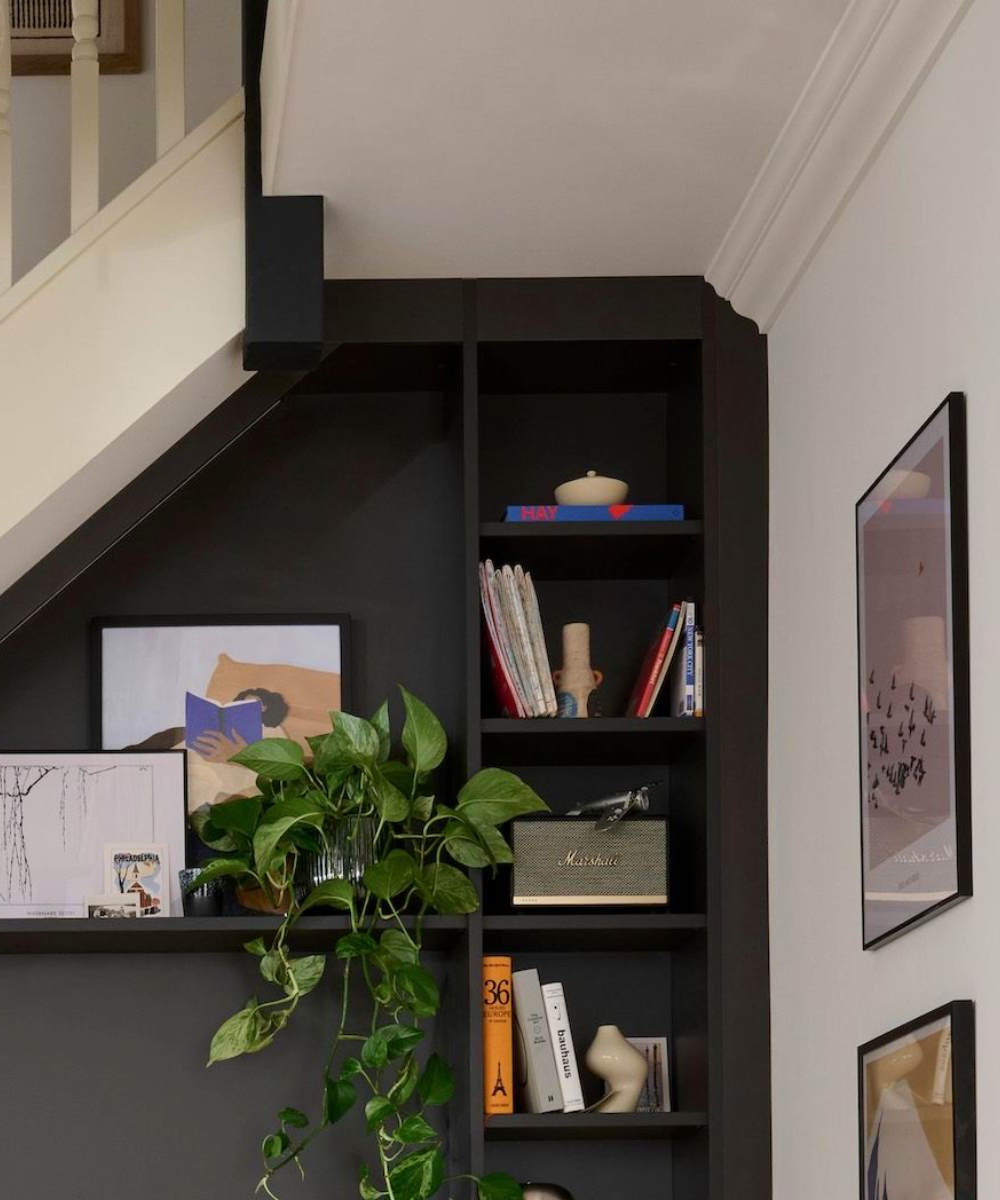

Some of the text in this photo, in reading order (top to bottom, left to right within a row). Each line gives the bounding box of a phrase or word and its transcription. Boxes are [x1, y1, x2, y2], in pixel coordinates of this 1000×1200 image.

[521, 505, 557, 520] HAY
[686, 642, 694, 660] YORK
[686, 660, 694, 675] CITY
[114, 853, 160, 863] PHILADELPHIA
[558, 850, 619, 866] Marshall
[484, 979, 510, 1005] 36
[483, 1010, 512, 1018] EUROPE
[557, 1029, 572, 1079] bauhaus
